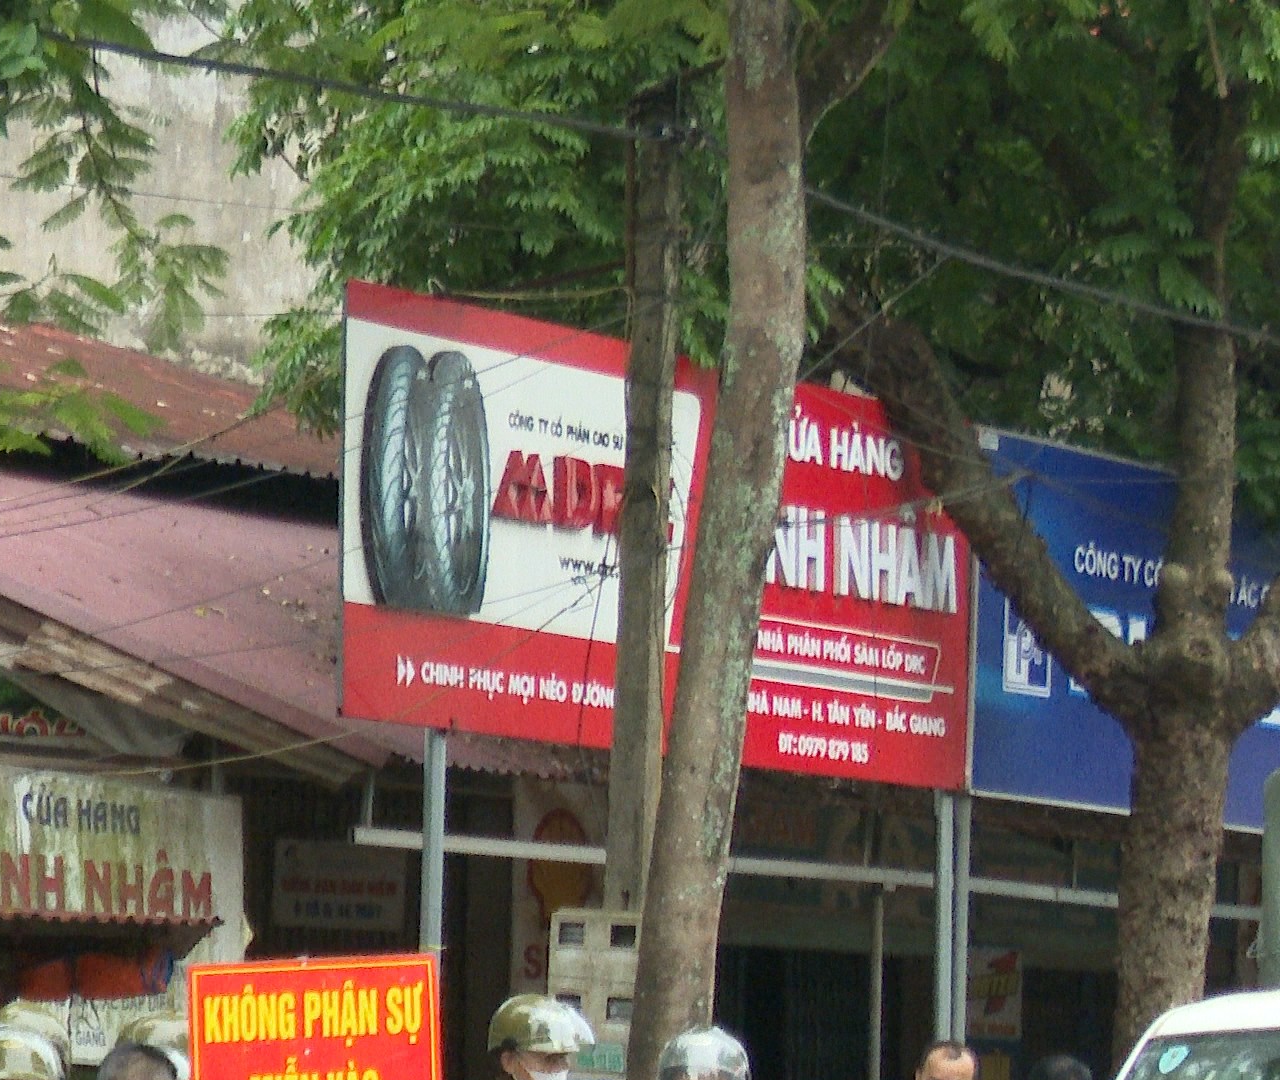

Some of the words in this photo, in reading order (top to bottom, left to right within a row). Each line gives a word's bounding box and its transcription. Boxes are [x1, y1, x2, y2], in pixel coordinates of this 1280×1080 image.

[788, 403, 823, 466] ỬA
[829, 420, 905, 481] HÀNG
[1073, 541, 1119, 580] CÔNG
[1122, 555, 1143, 584] TY
[468, 667, 504, 701] PHỤC
[508, 672, 535, 705] MỌI
[772, 696, 802, 720] NAM
[204, 983, 296, 1044] KHÔNG
[304, 979, 378, 1047] PHẬN
[385, 980, 423, 1045] SỰ
